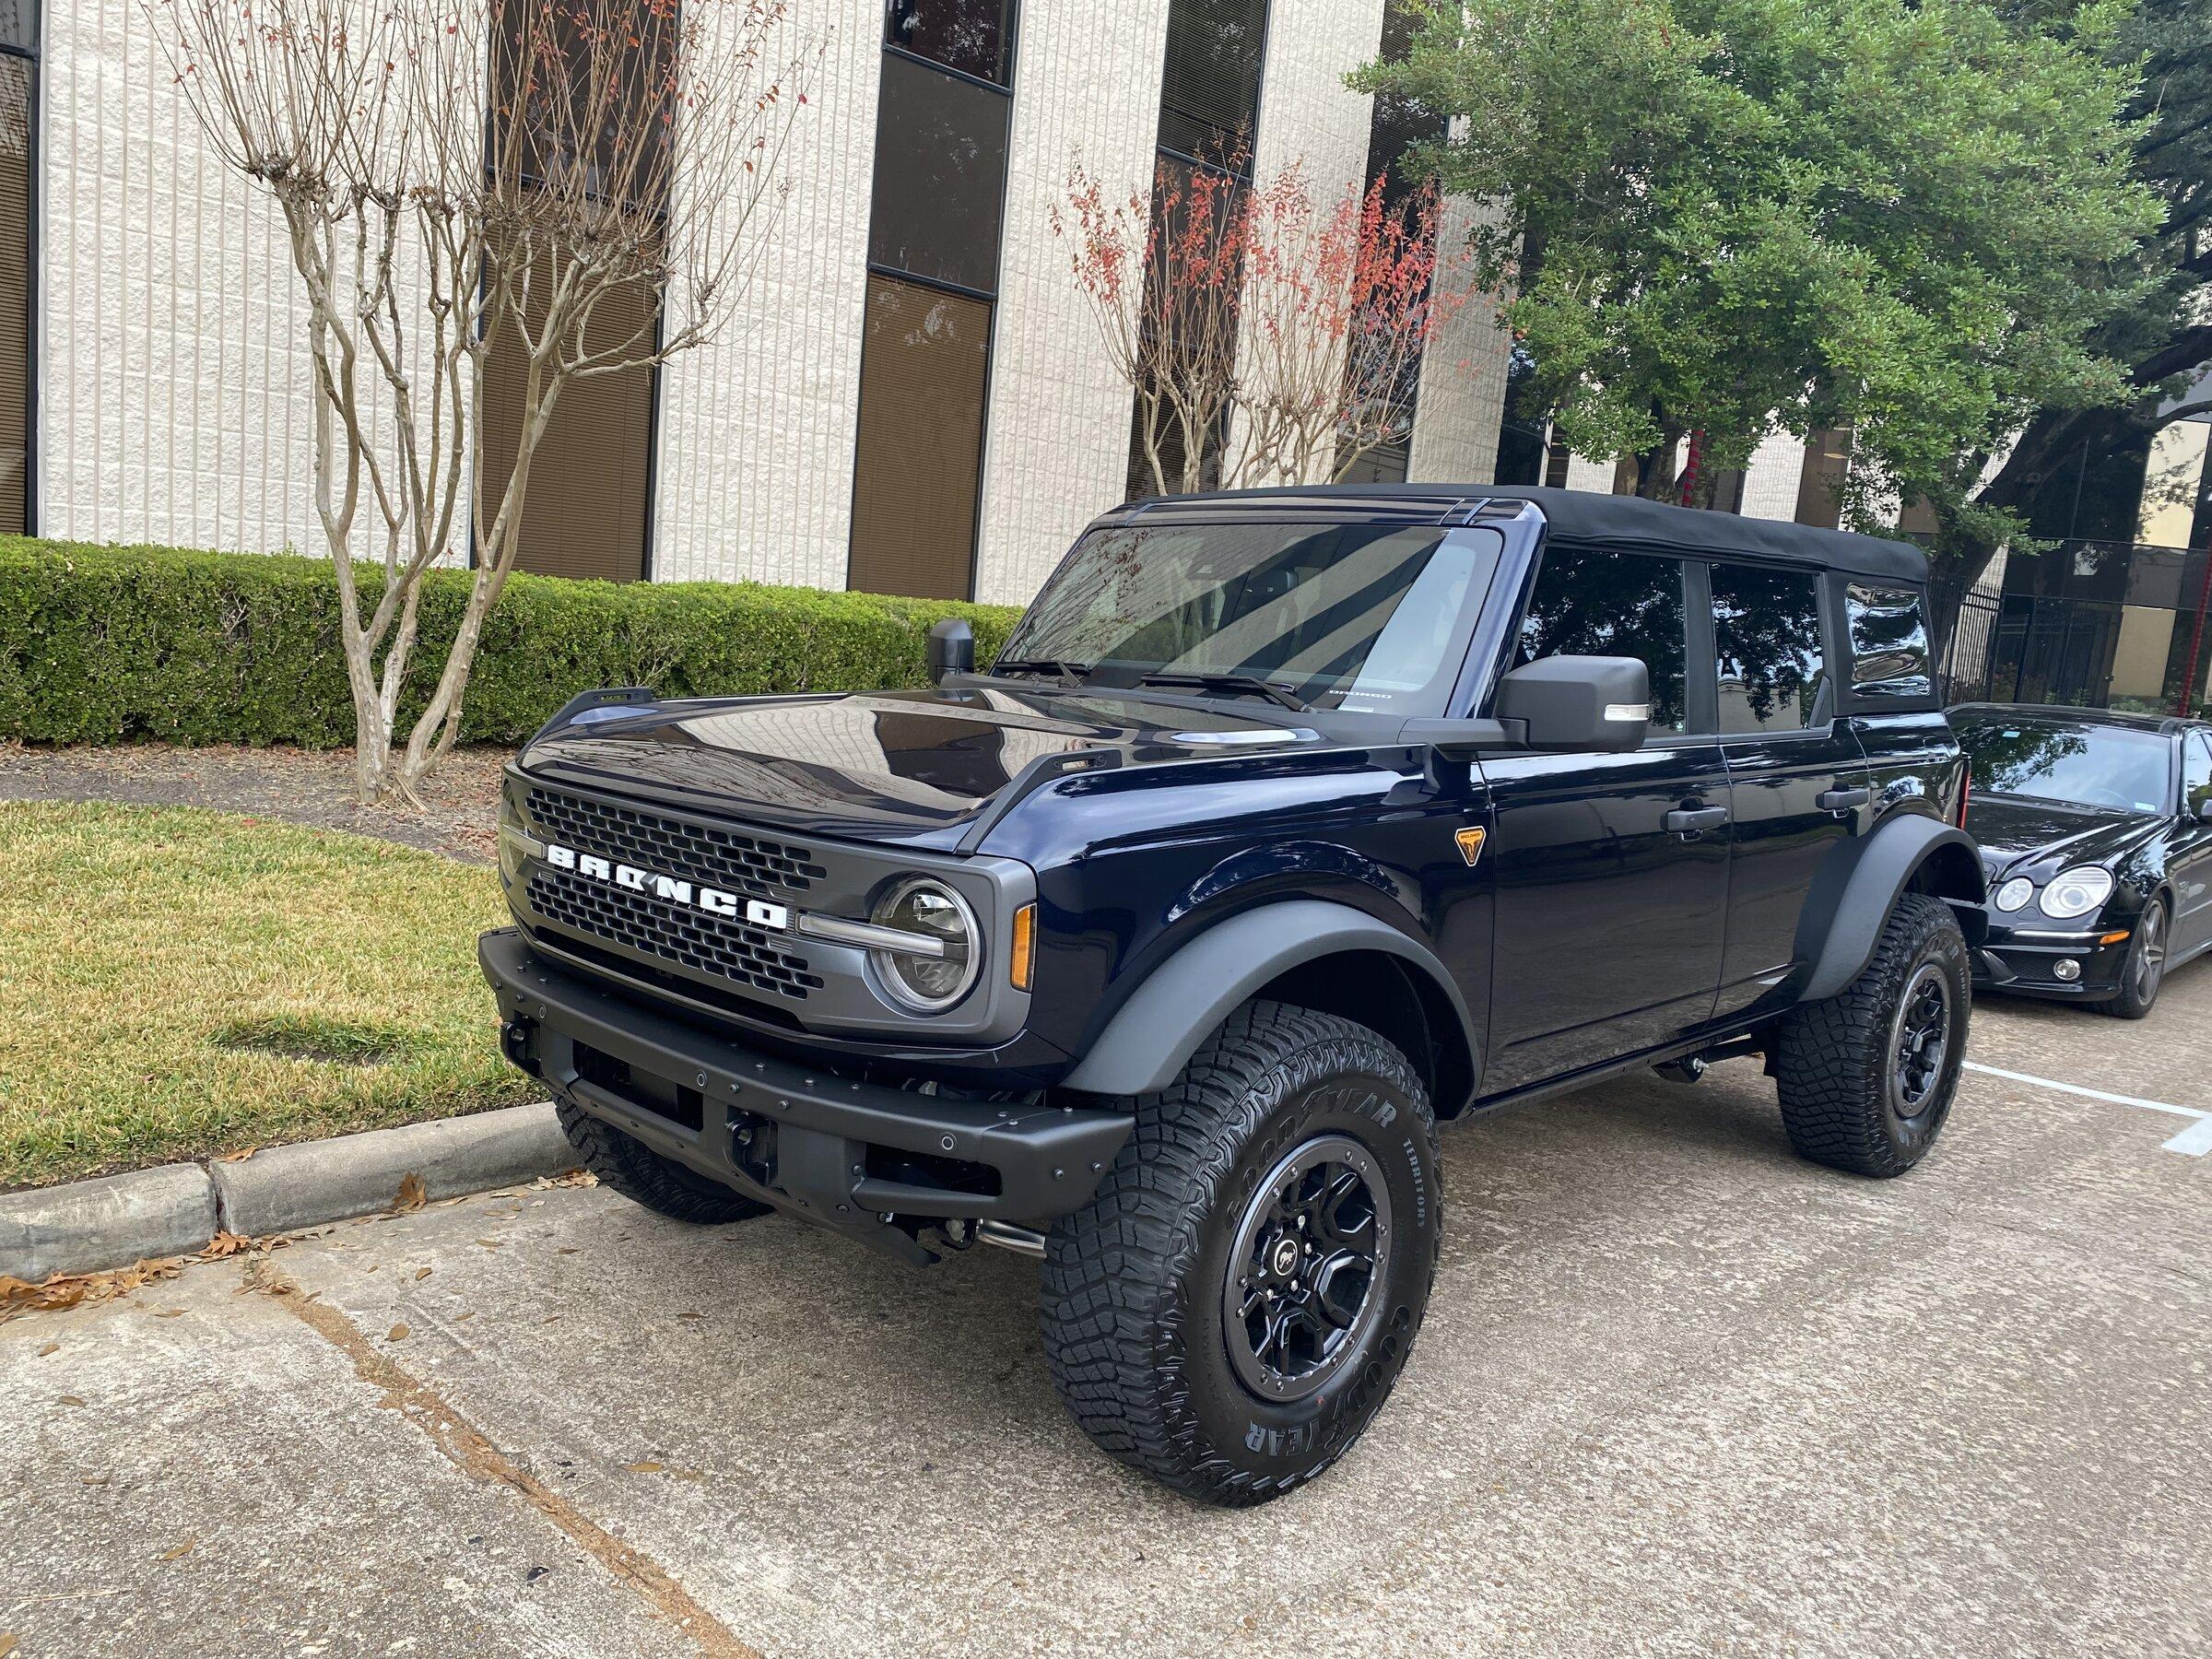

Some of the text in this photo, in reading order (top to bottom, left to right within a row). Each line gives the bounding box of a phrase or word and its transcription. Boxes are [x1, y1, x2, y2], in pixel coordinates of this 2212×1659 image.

[1329, 689, 1392, 699] BRONCO
[547, 844, 787, 929] BRONCO
[1403, 1137, 1426, 1229] TERRITORY
